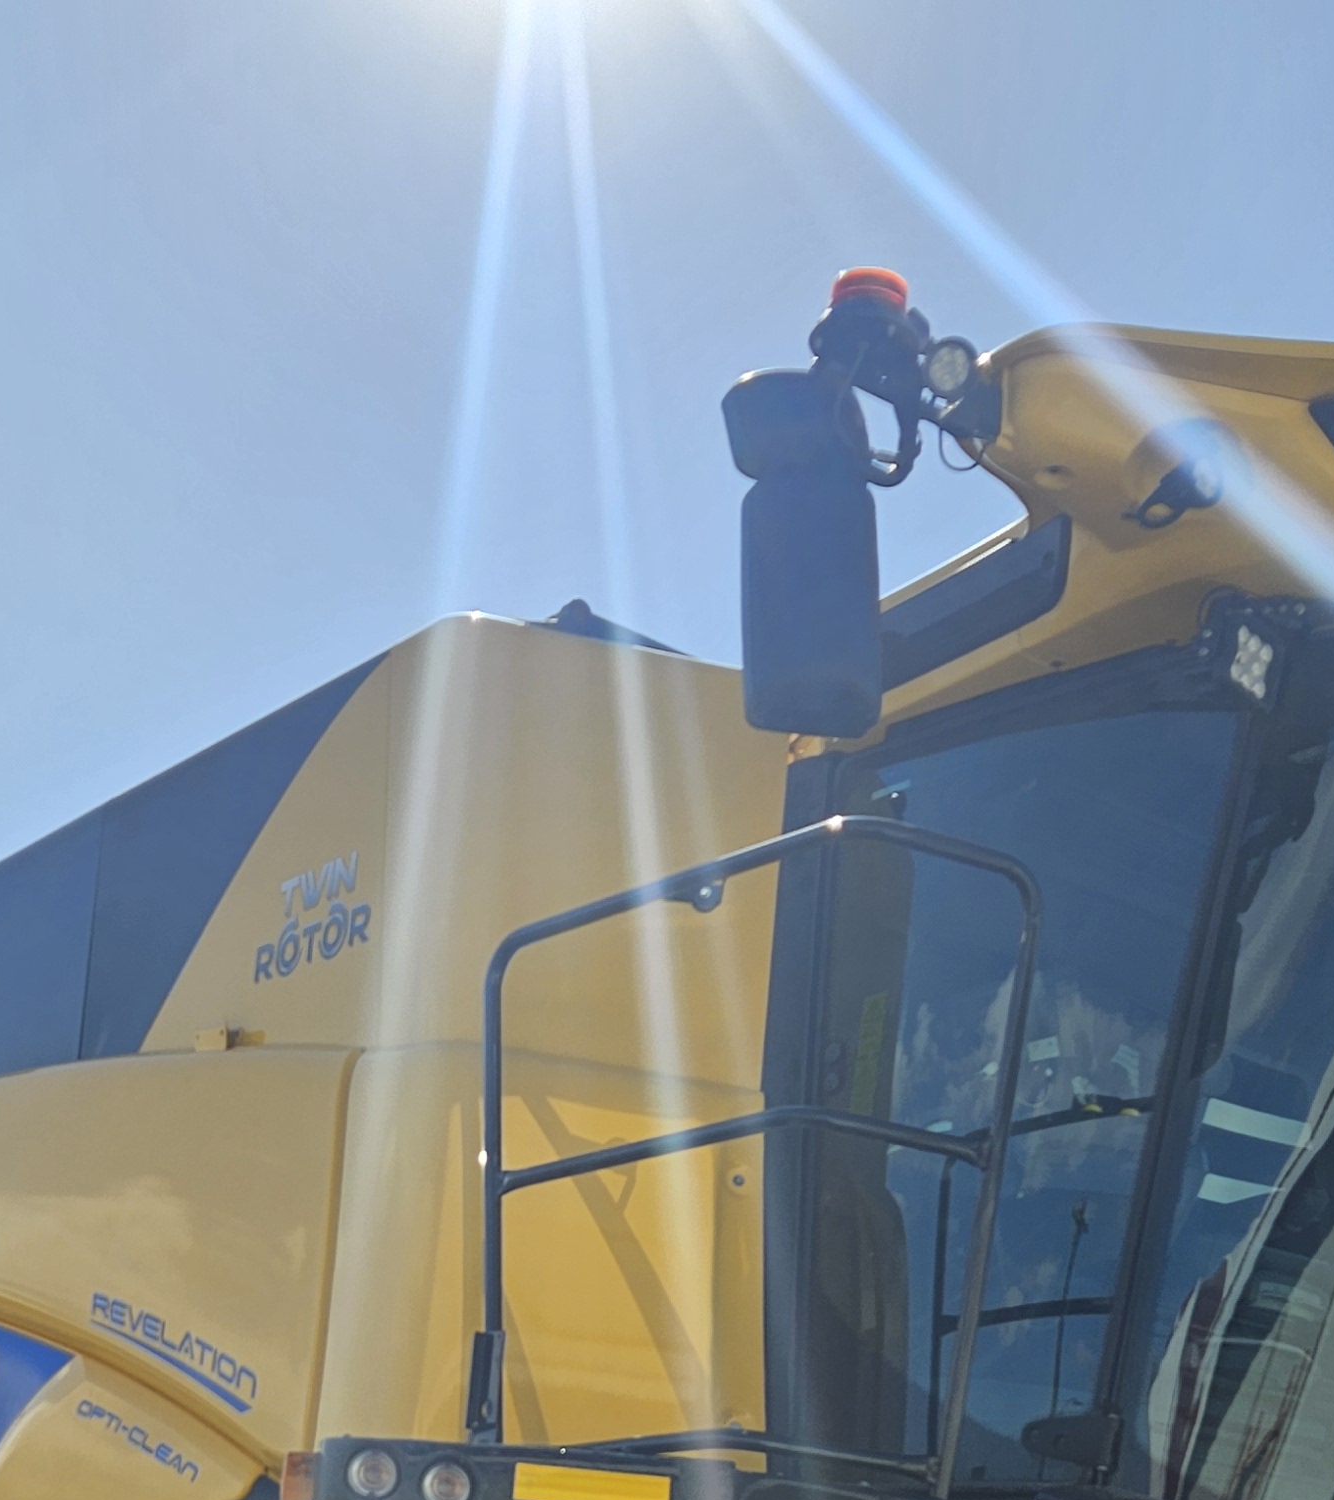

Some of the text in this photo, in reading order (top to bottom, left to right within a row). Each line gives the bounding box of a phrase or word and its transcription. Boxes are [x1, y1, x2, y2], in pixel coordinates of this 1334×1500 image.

[281, 850, 358, 917] TWIN
[254, 900, 371, 984] ROTOR
[91, 1292, 257, 1399] REVELATION
[77, 1400, 199, 1483] OPTI-CLEAN
